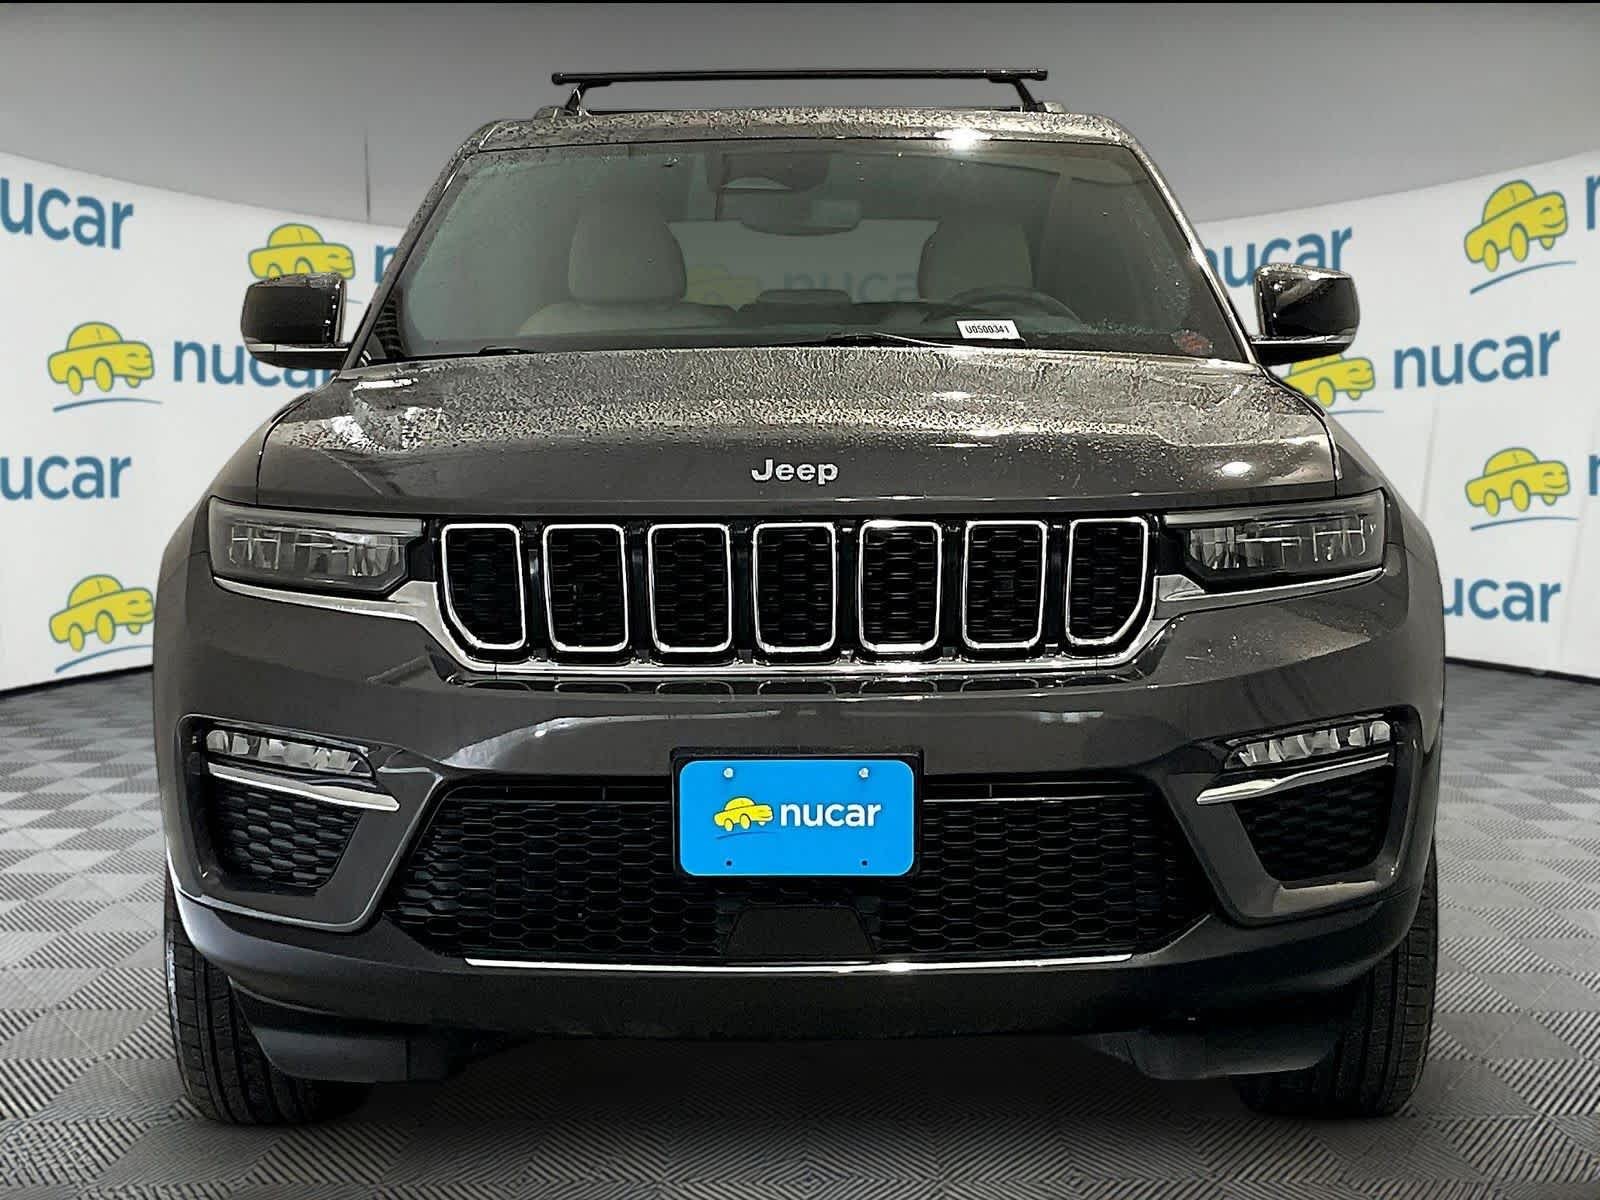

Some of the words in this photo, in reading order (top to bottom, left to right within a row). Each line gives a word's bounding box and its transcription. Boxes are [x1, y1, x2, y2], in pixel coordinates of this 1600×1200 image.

[1394, 330, 1560, 389] nucar
[751, 459, 839, 485] Jeep
[780, 802, 882, 827] nucar
